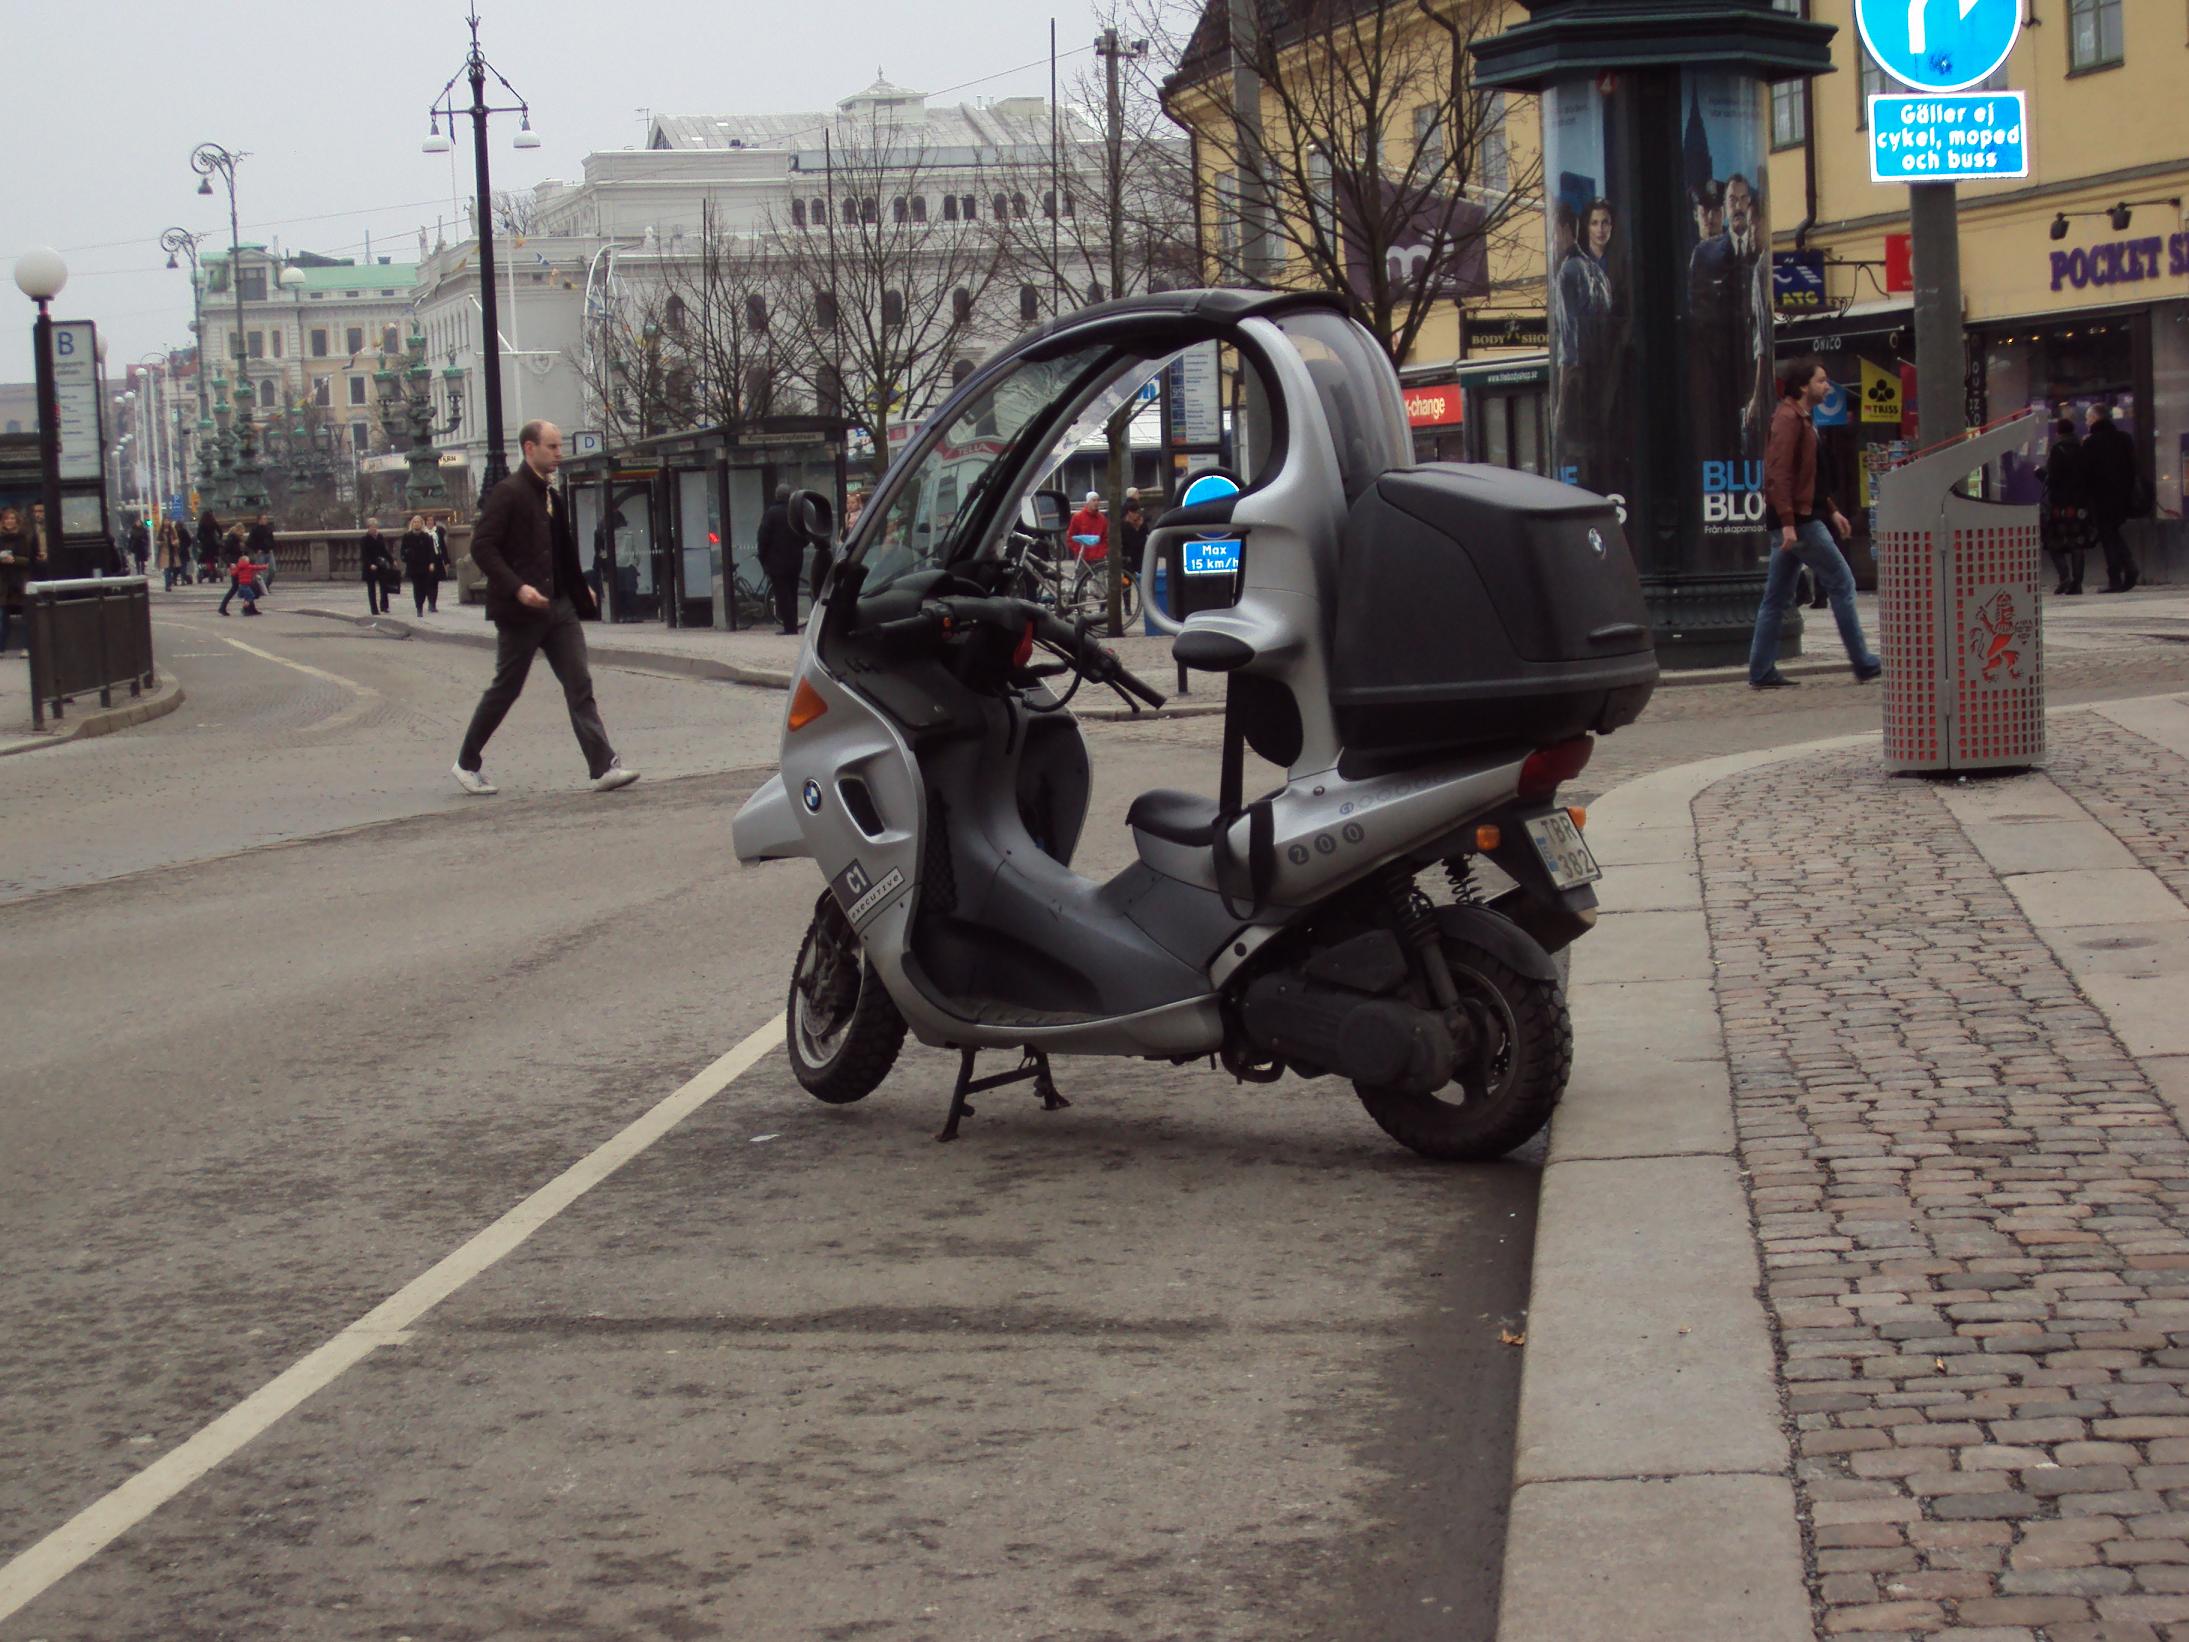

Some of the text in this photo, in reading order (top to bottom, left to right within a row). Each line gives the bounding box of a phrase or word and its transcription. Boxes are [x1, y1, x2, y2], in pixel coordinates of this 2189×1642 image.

[1900, 102, 1994, 126] Gäller ej
[1877, 124, 2019, 152] cykel, moped
[1902, 149, 1997, 170] och buss
[2049, 236, 2162, 292] POCKET
[1782, 290, 1819, 305] ATG
[58, 331, 74, 356] B
[1472, 335, 1505, 344] BODY
[1873, 404, 1899, 415] TRISS
[584, 436, 595, 449] D
[1703, 460, 1764, 492] BLU
[1704, 491, 1767, 522] BLO
[1704, 524, 1723, 534] Från
[1202, 545, 1227, 556] Max
[1192, 557, 1239, 570] 15 km/h
[1557, 849, 1595, 879] 382
[846, 865, 867, 894] C1
